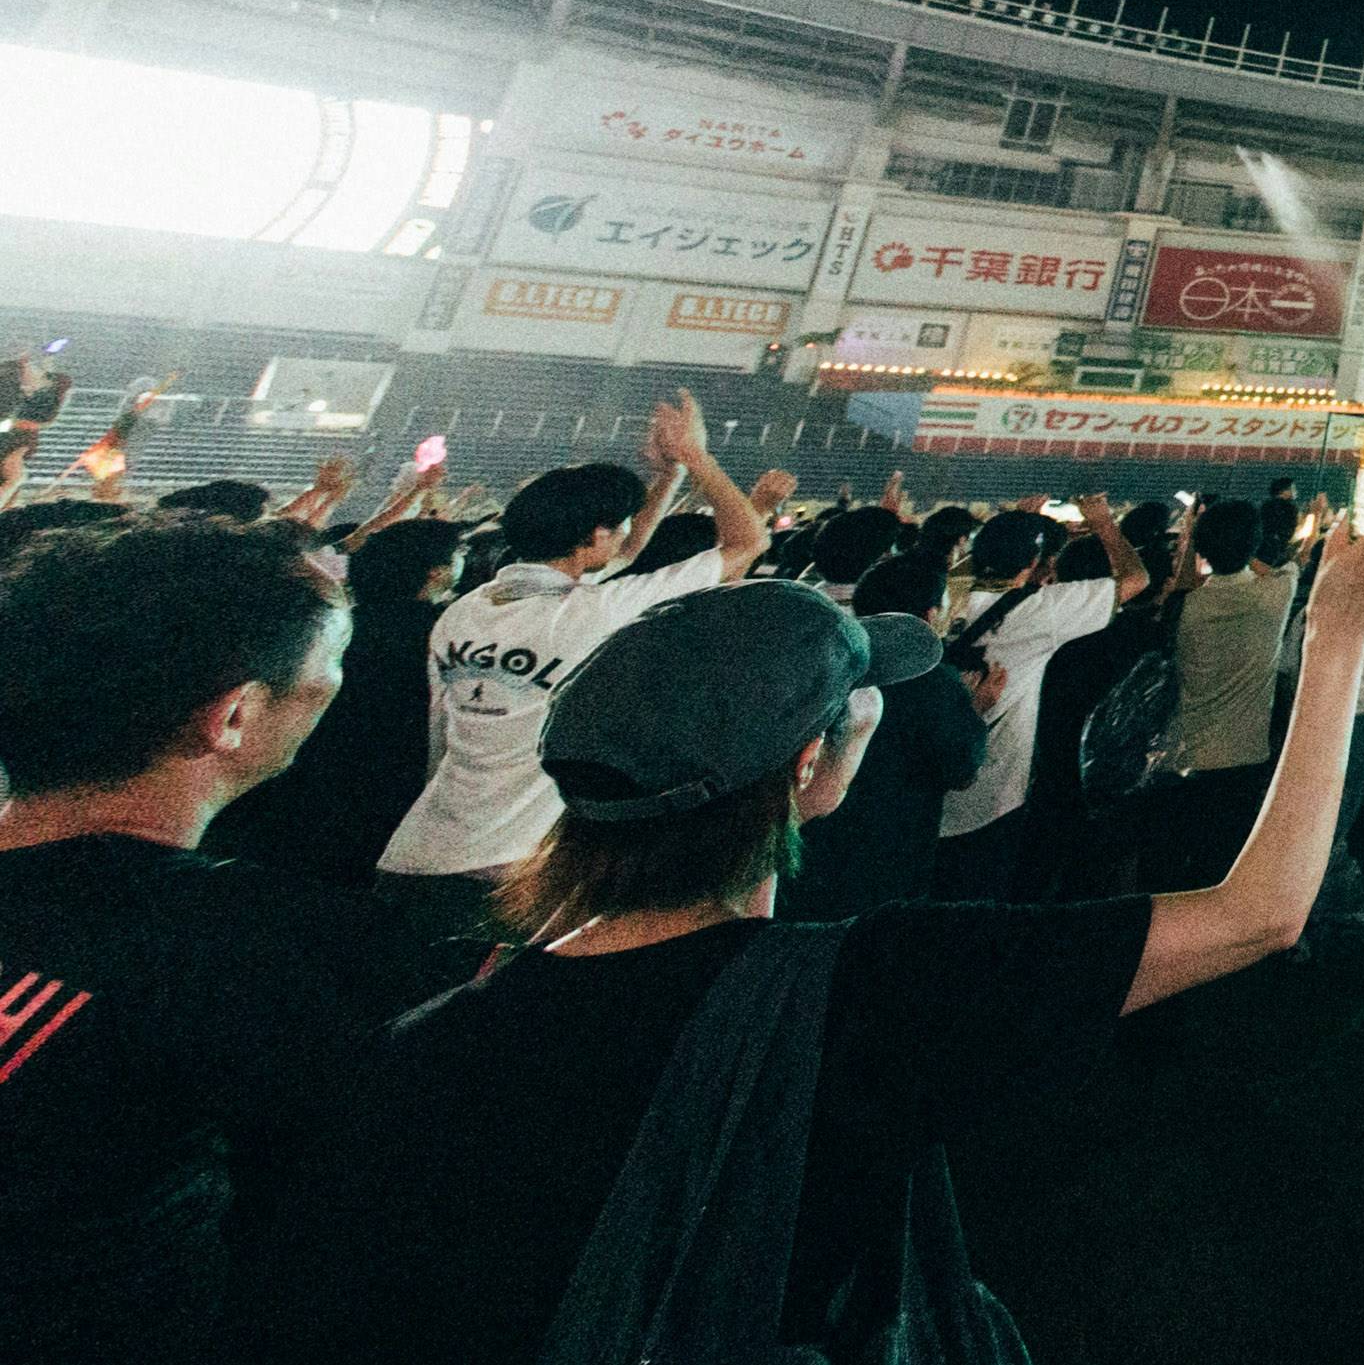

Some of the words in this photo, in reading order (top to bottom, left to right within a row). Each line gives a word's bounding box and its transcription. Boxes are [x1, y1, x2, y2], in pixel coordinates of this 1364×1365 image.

[596, 220, 815, 261] エイジェック
[919, 245, 1107, 291] 千葉銀行
